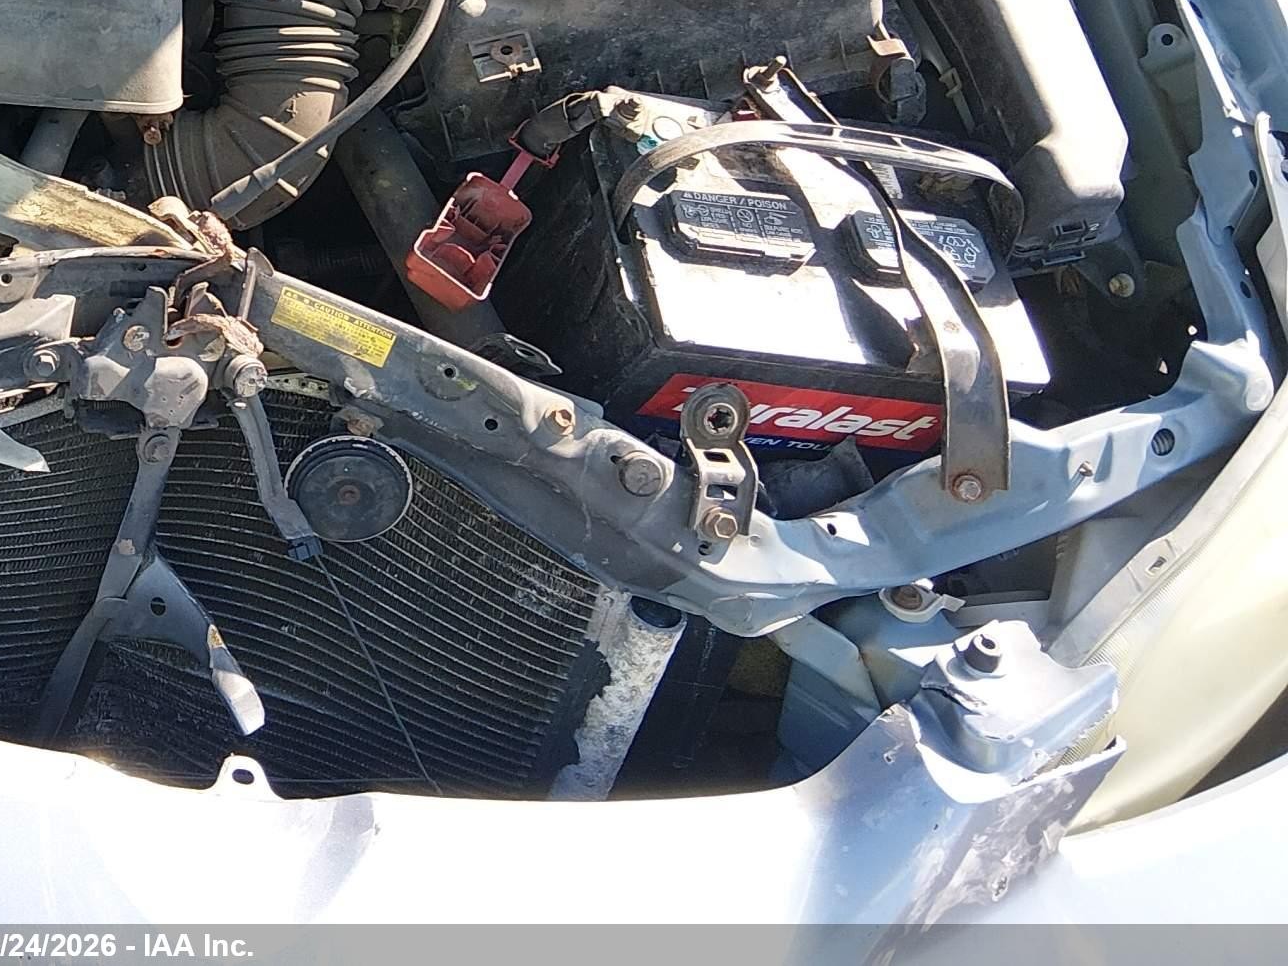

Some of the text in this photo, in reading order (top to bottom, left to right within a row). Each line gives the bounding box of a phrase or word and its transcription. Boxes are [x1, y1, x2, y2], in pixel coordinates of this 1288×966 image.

[694, 192, 737, 205] DANGER
[747, 199, 788, 211] POISON
[314, 302, 394, 340] CAUTION ATTENTION
